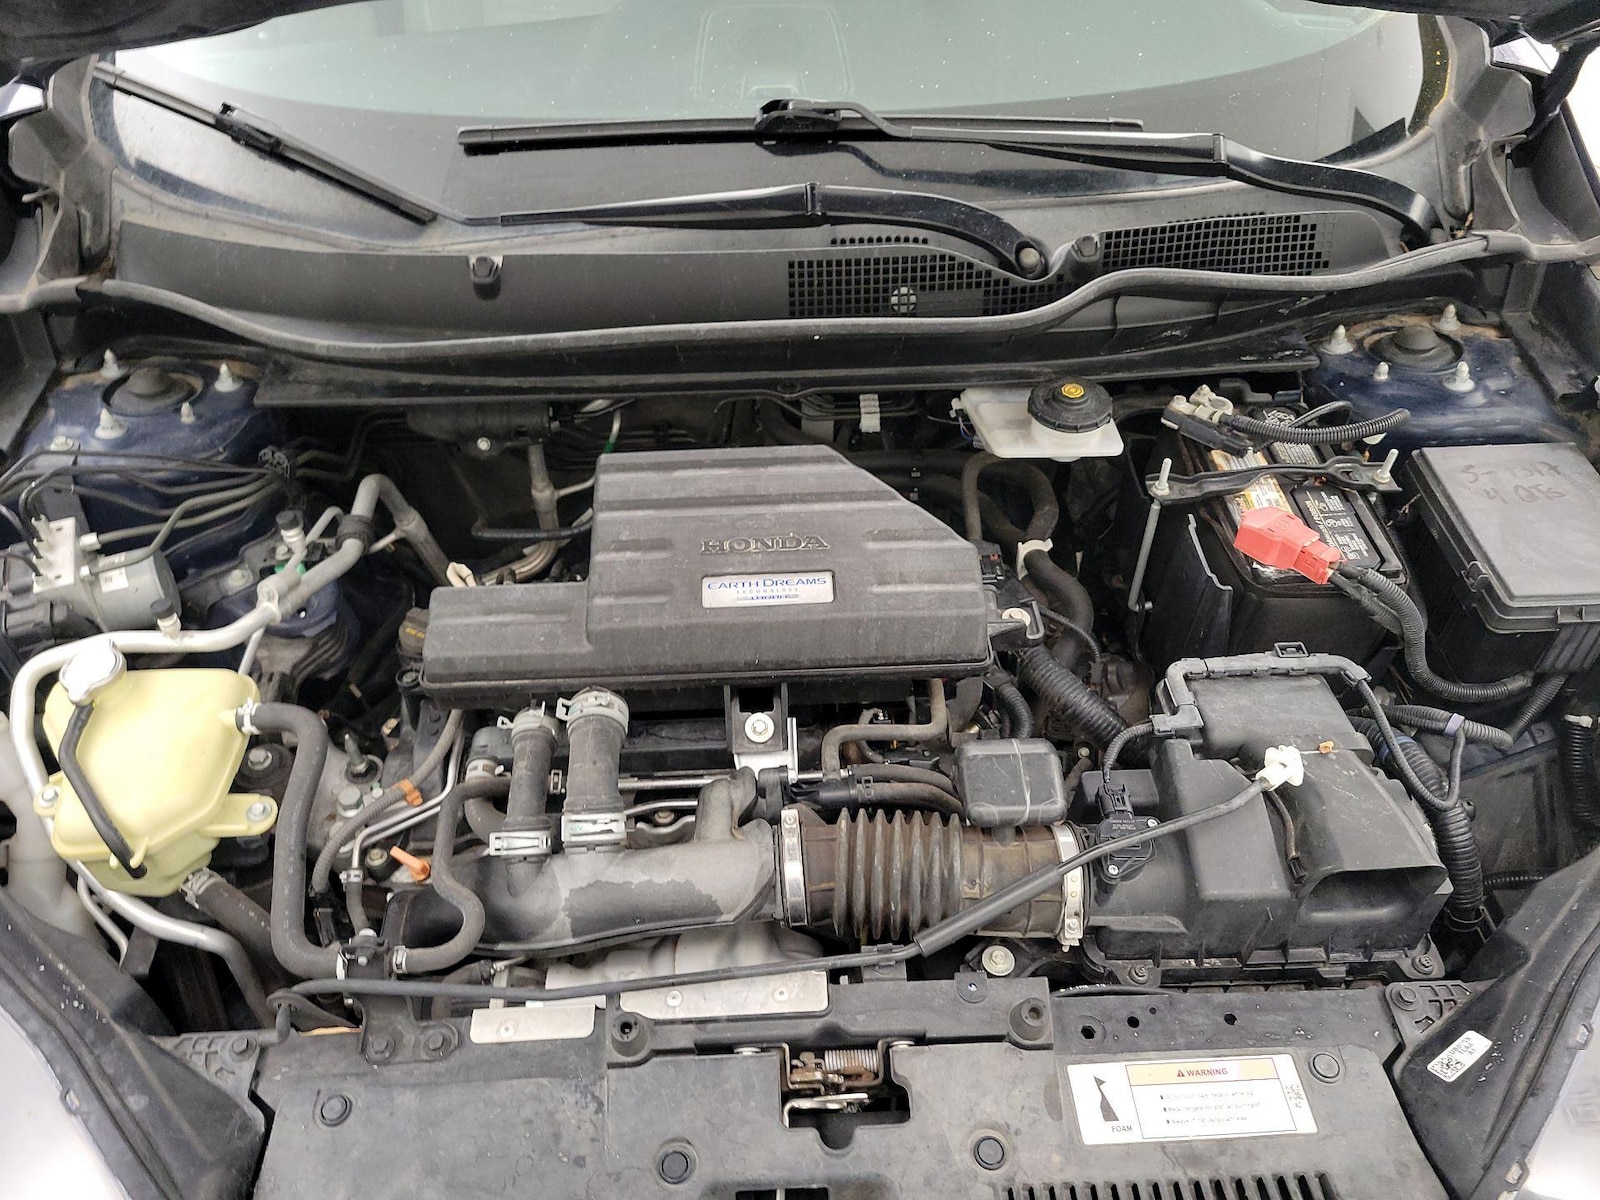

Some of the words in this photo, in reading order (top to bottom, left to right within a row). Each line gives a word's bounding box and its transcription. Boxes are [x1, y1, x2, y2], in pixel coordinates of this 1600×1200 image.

[701, 535, 830, 553] HONDA
[707, 580, 759, 590] EARTH
[1186, 1067, 1229, 1078] WARNING
[1111, 1125, 1133, 1133] FOAM
